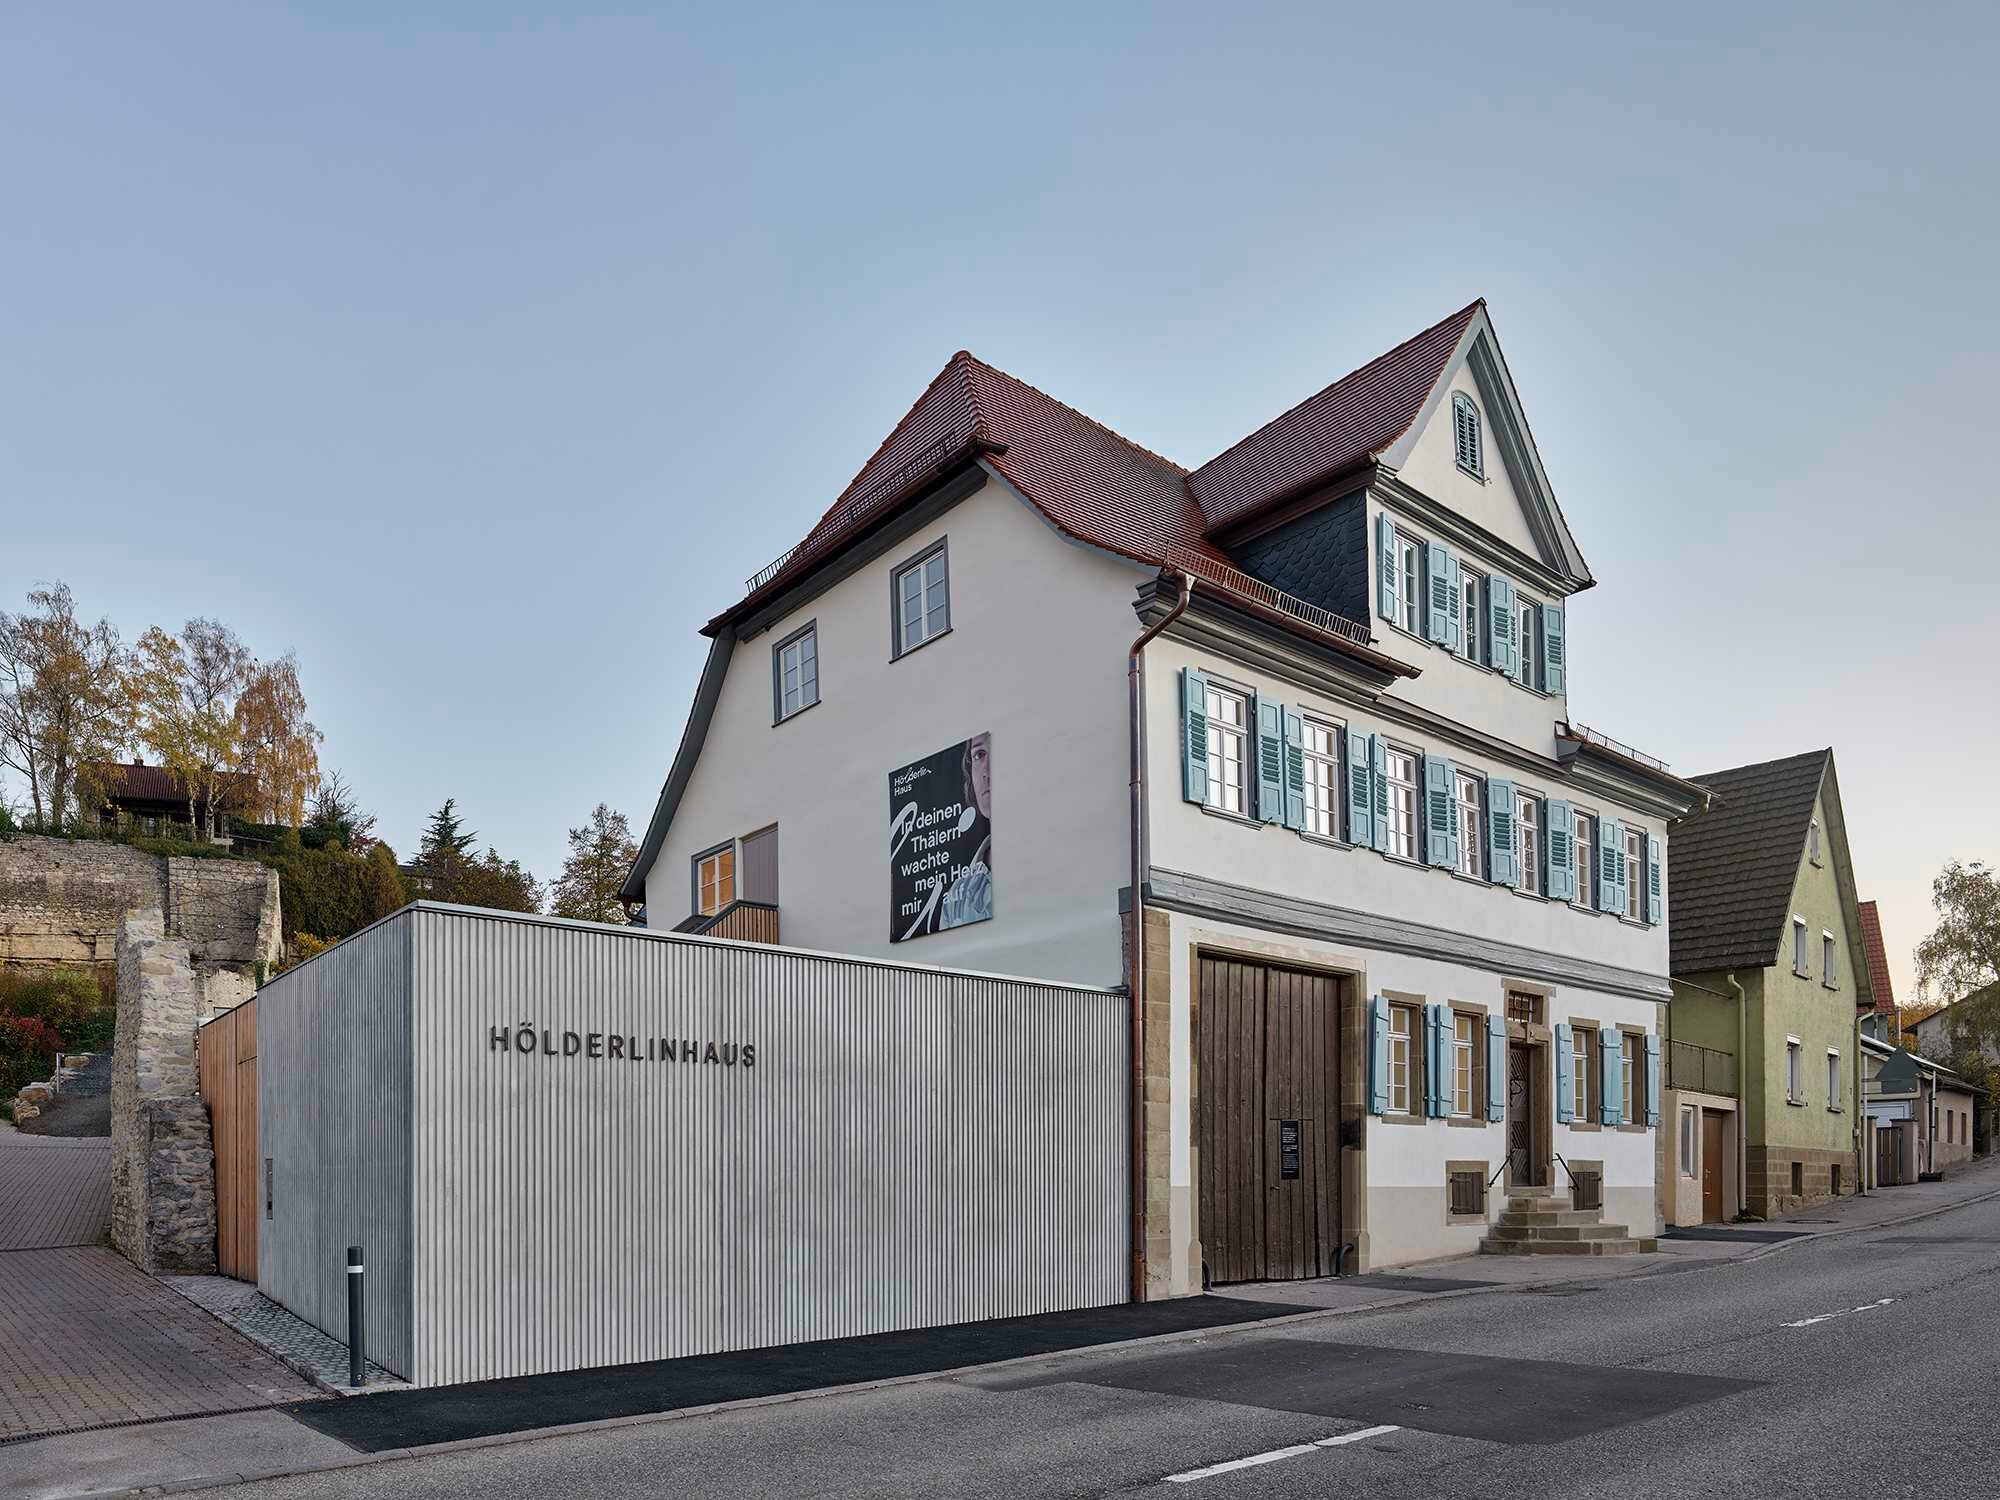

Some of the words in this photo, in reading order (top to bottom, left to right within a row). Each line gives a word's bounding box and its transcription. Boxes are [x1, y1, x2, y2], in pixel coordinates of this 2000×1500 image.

[894, 784, 912, 797] Haus
[916, 803, 962, 829] deinen
[911, 826, 961, 853] Thälern
[901, 851, 949, 877] wachte
[915, 870, 947, 893] mein
[901, 897, 922, 917] mir
[490, 1021, 757, 1068] HÖLDERLINHAUS
